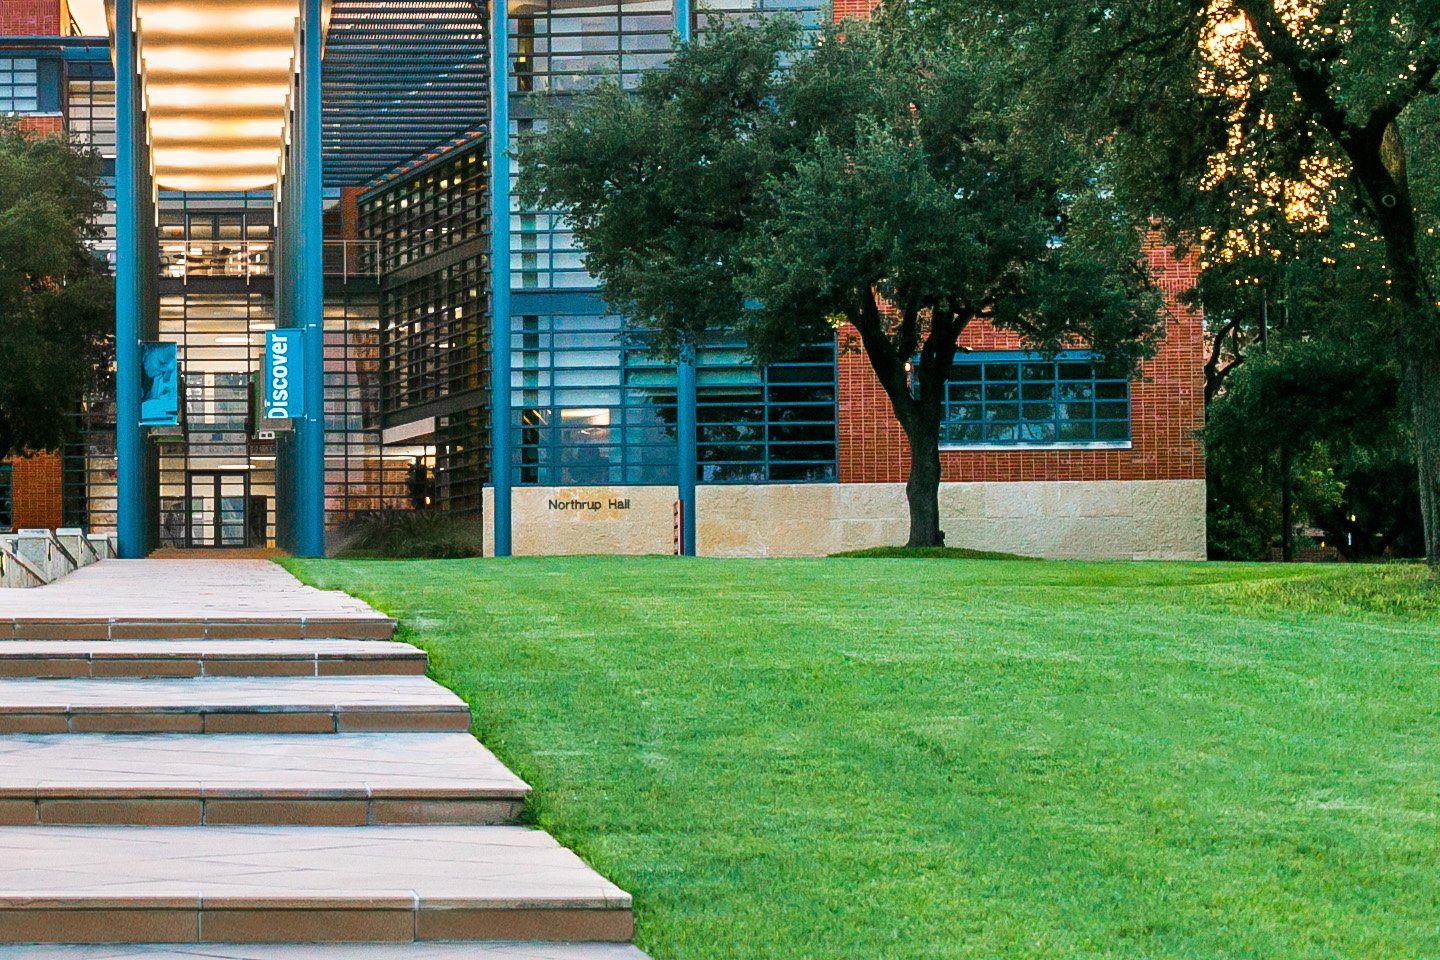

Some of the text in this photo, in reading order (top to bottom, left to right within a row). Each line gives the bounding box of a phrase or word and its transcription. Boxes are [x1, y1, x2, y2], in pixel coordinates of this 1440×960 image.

[267, 334, 288, 419] Discover
[548, 498, 631, 512] Northrup Hall
